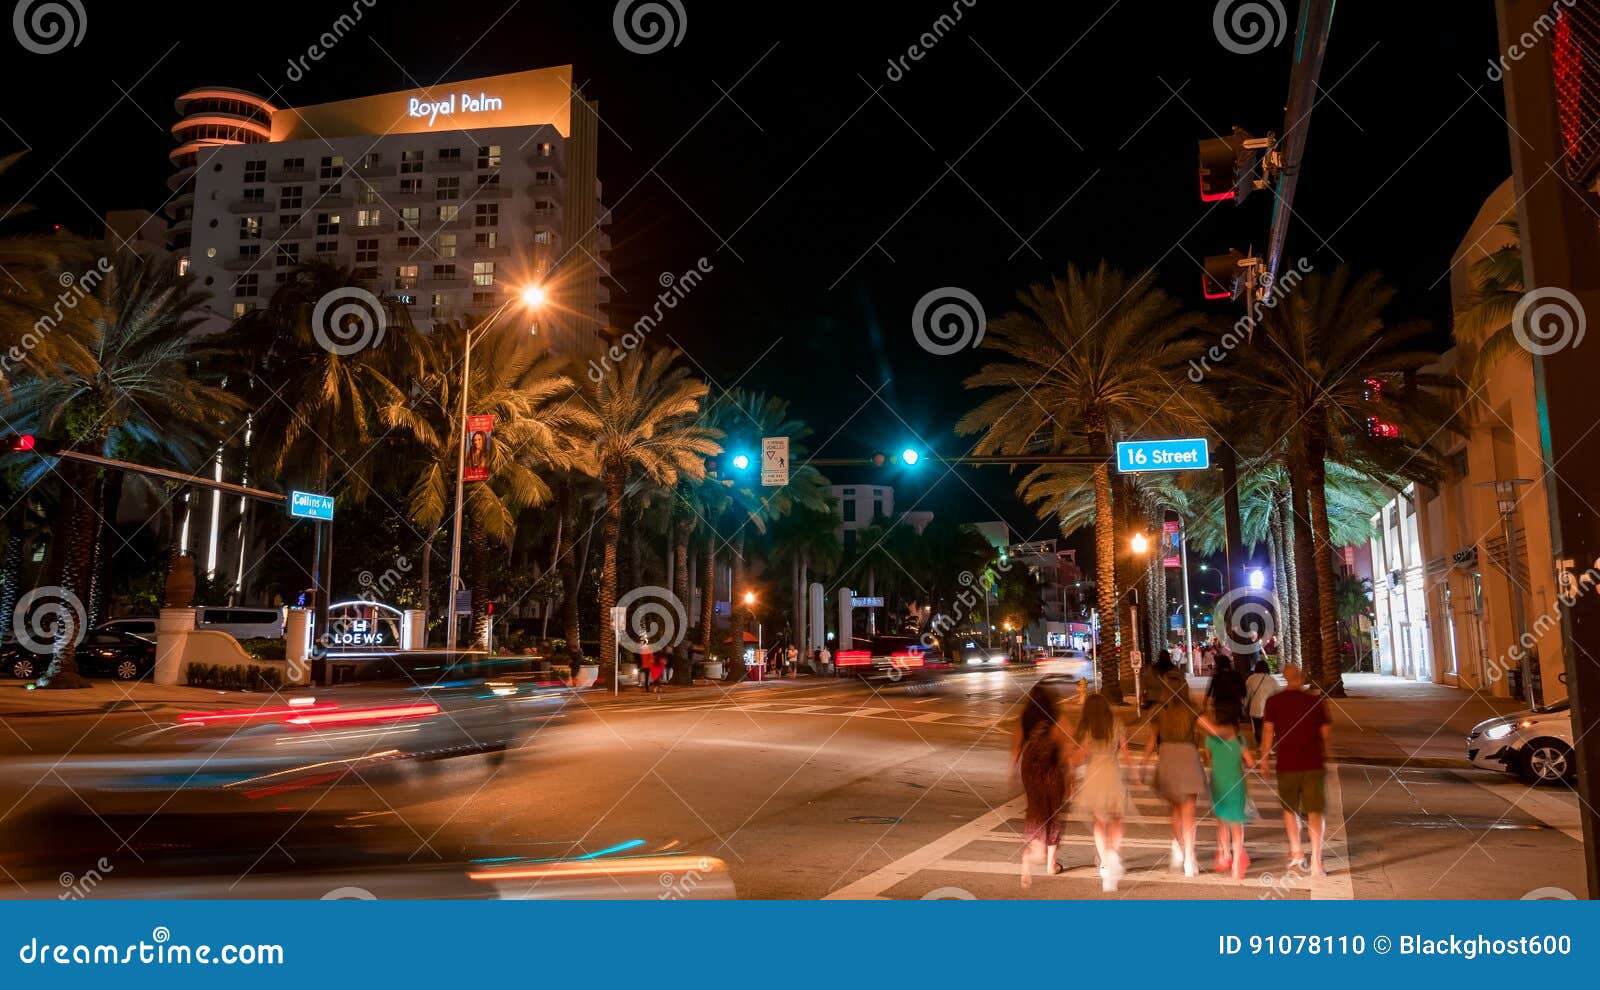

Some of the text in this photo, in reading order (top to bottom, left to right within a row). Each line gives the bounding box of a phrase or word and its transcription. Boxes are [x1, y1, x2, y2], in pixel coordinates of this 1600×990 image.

[409, 92, 502, 128] Royal Palm
[1127, 447, 1199, 465] 16 Street
[294, 493, 332, 510] Collins Av
[334, 633, 383, 644] LOEWS
